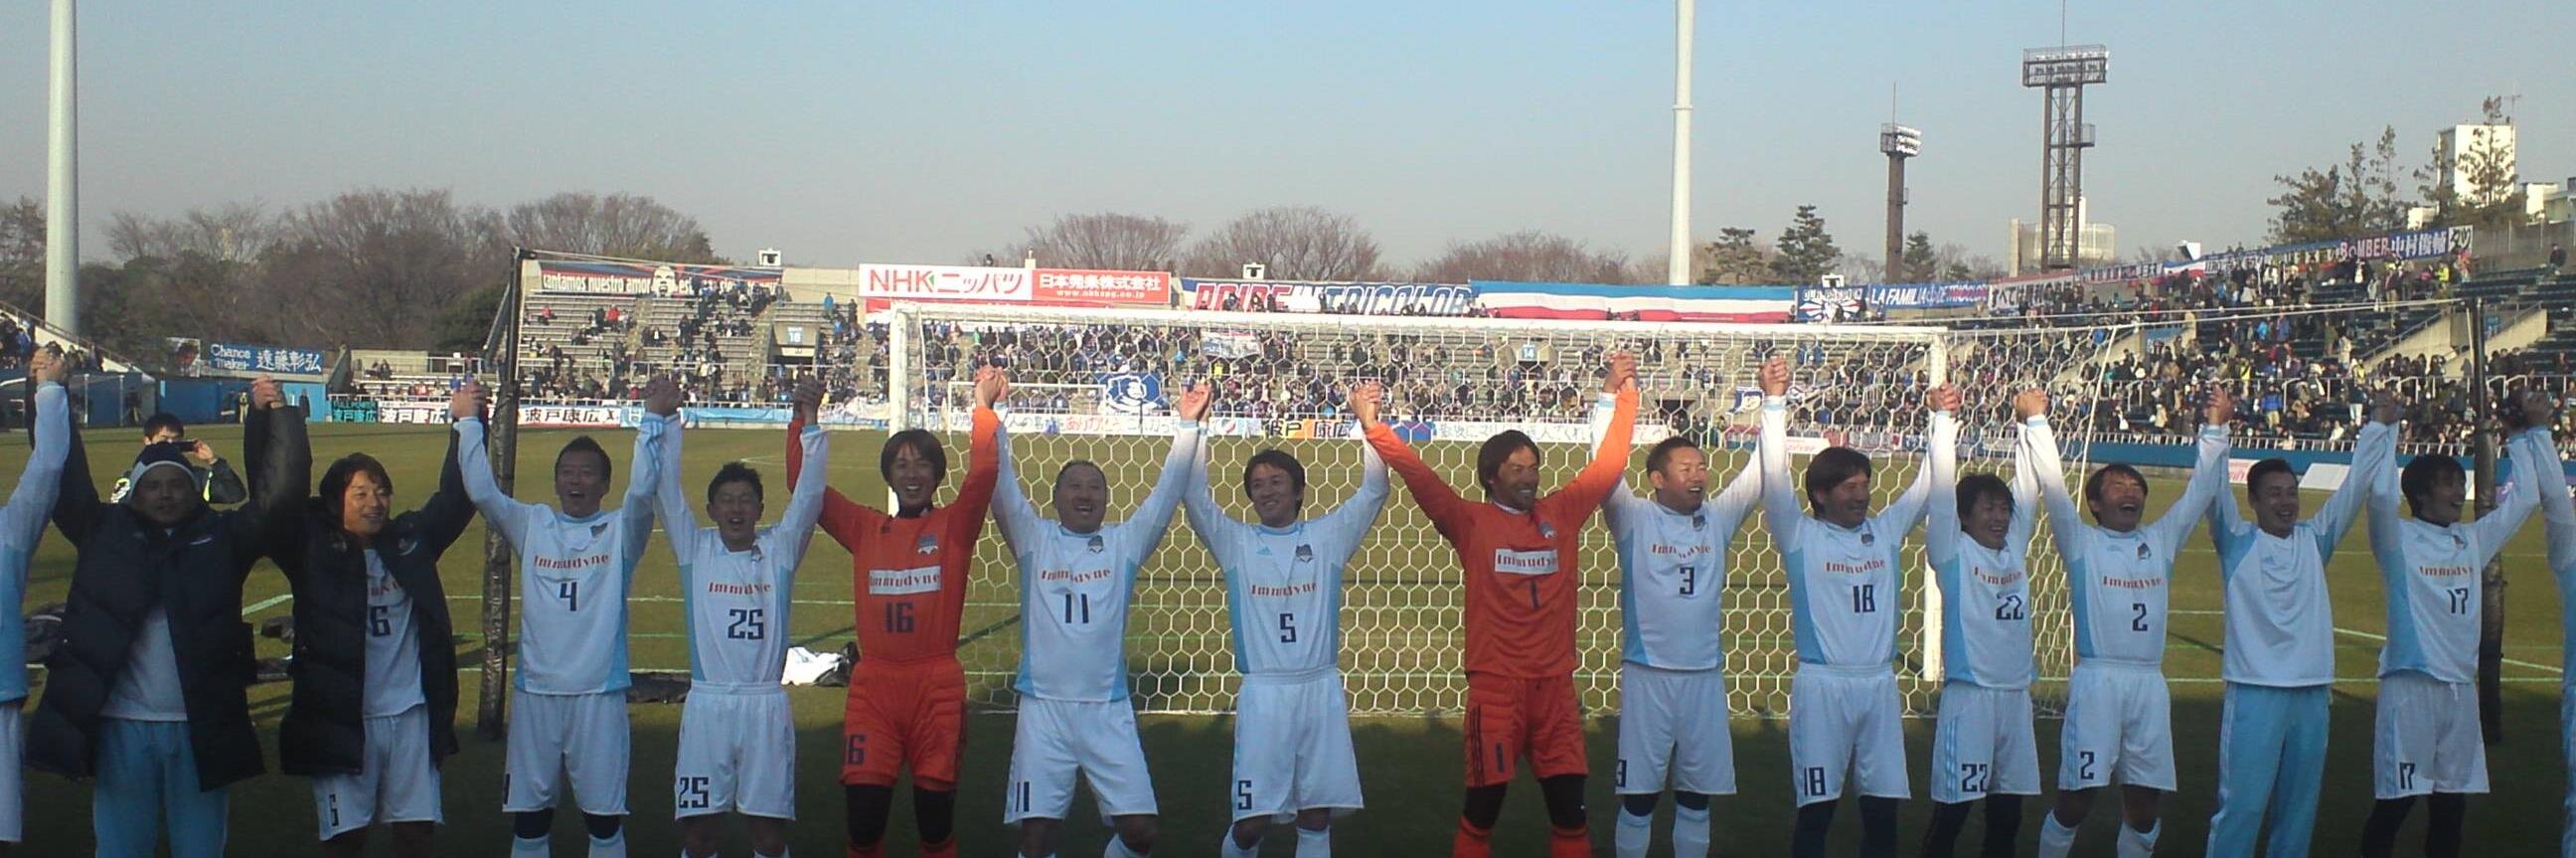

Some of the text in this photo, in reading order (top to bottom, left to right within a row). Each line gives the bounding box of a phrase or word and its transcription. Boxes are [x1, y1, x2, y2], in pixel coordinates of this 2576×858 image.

[870, 268, 933, 293] NHK
[937, 272, 1023, 293] ニッパツ
[1871, 287, 1887, 304] LA
[525, 408, 600, 424] 波戸康広
[1680, 566, 1695, 596] 3
[559, 582, 577, 612] 4
[1064, 593, 1090, 624] 11
[1852, 584, 1876, 613] 18
[1996, 593, 2024, 620] 22
[2447, 588, 2469, 615] 17
[727, 607, 765, 640] 25
[886, 601, 914, 634] 16
[1279, 612, 1297, 643] 5
[2132, 602, 2148, 632] 2
[1962, 763, 1989, 793] 22
[2080, 751, 2095, 780] 2
[2399, 761, 2416, 790] 17
[678, 776, 710, 809] 25
[1237, 779, 1252, 810] 5
[1804, 767, 1826, 798] 18
